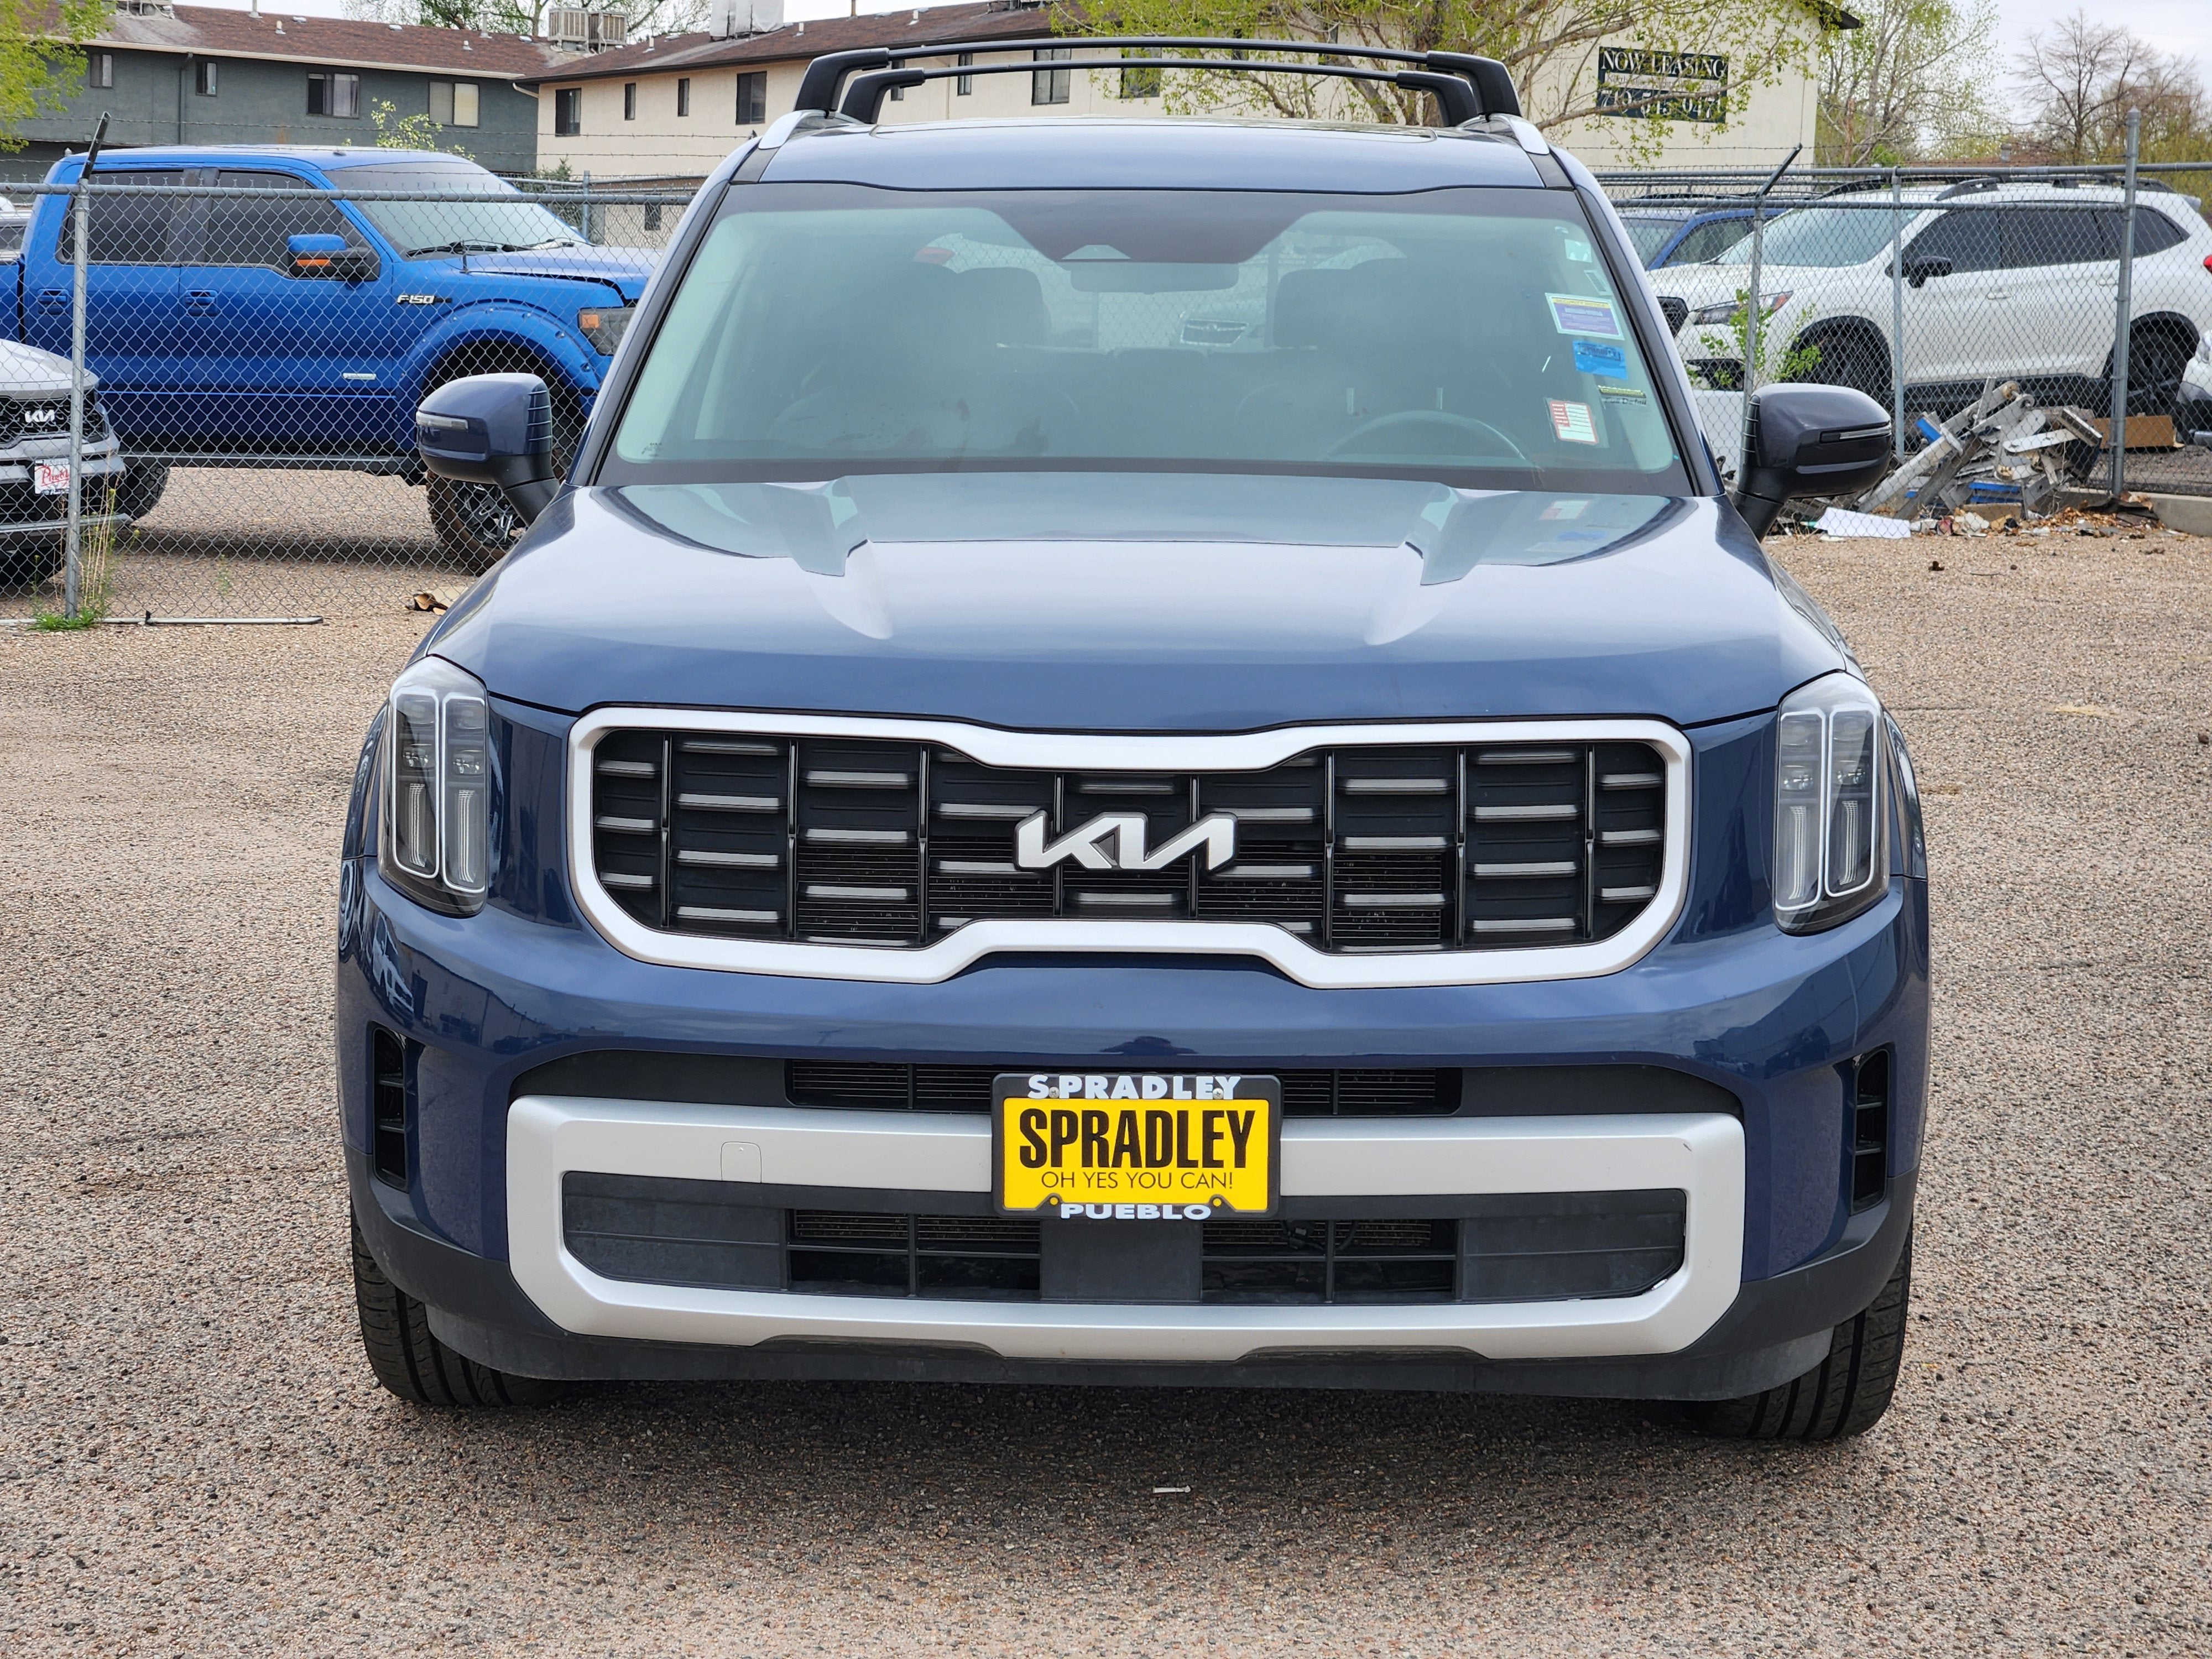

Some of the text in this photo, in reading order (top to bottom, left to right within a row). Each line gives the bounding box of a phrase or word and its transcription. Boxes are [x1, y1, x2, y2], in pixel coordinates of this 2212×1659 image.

[1601, 50, 1724, 78] NOW LEASING
[397, 295, 435, 304] F-150
[25, 409, 55, 423] KIA
[41, 466, 70, 484] Puebl
[1015, 810, 1238, 871] KIA
[1027, 1074, 1241, 1100] SPRADLEY
[1019, 1108, 1256, 1168] SPRADLEY
[1041, 1171, 1233, 1190] OH YES YOU CAN!
[1060, 1203, 1212, 1220] PUEBLO
